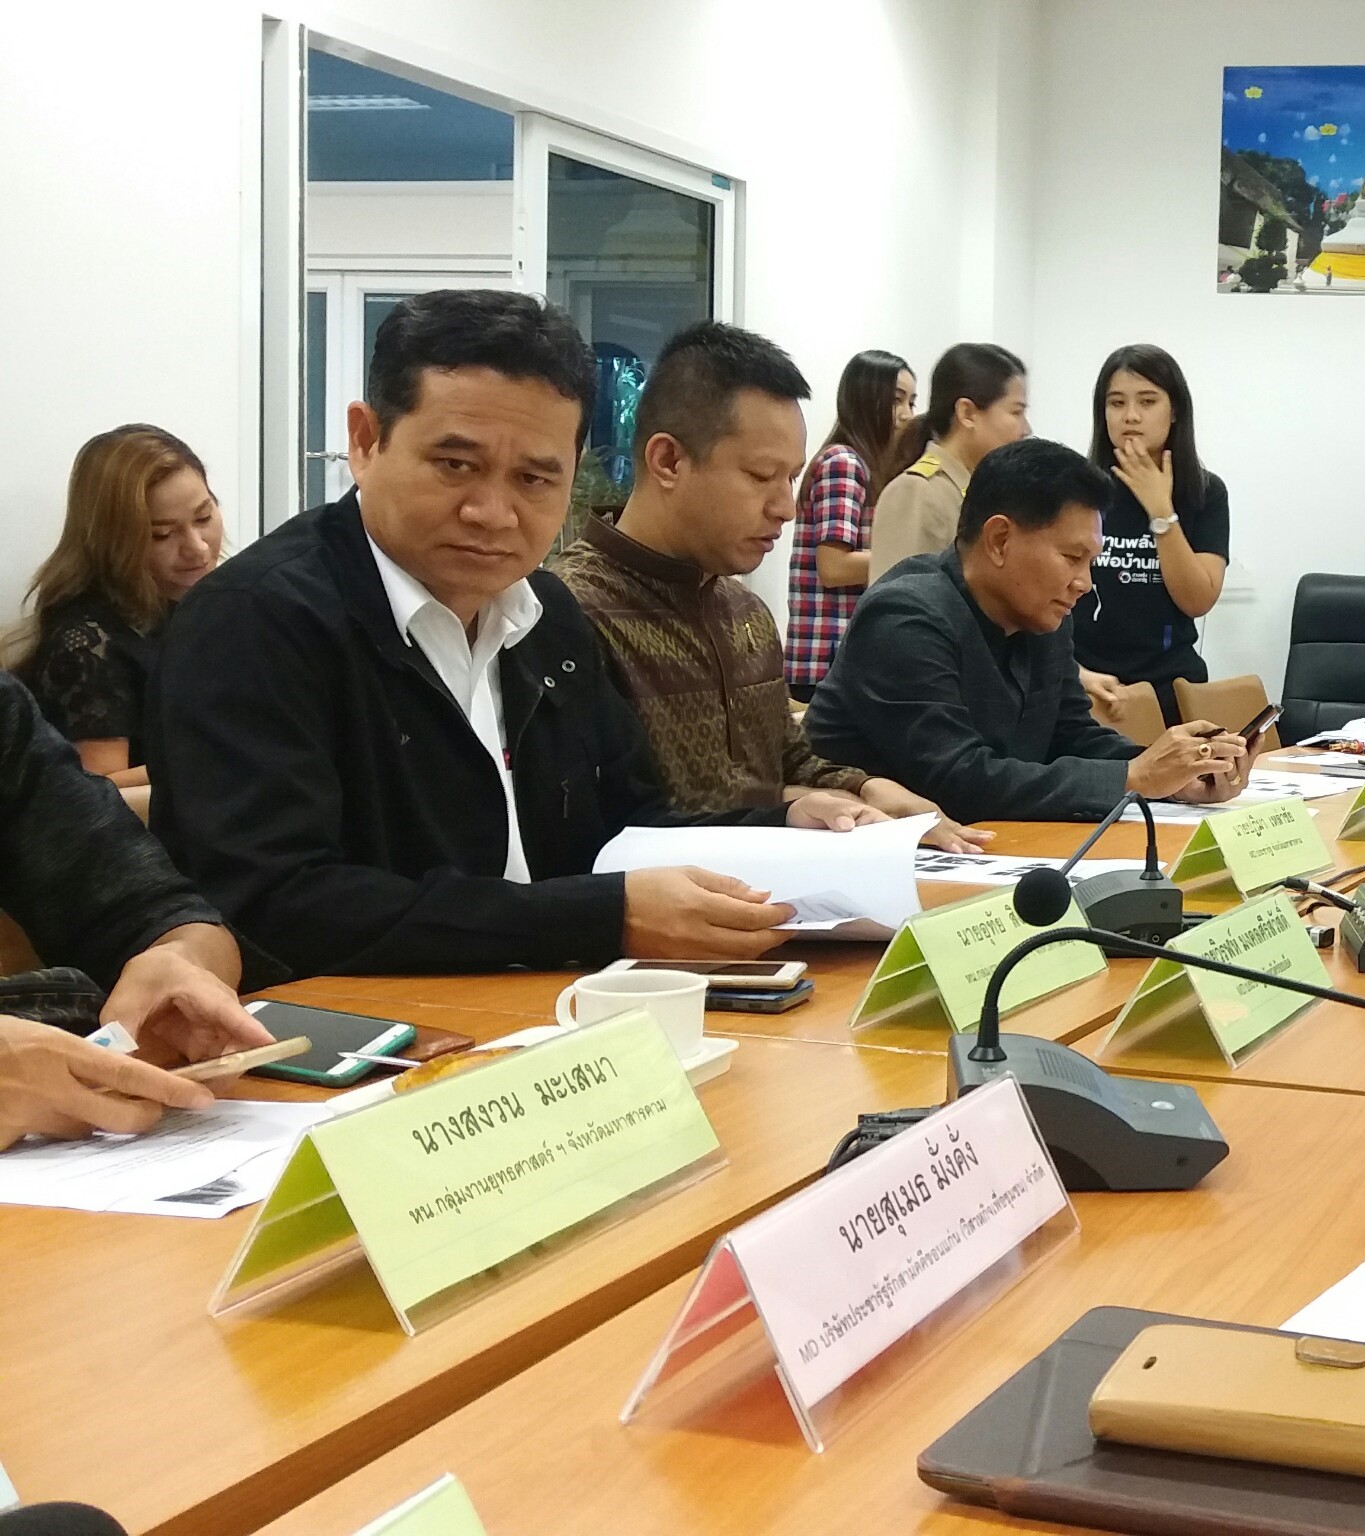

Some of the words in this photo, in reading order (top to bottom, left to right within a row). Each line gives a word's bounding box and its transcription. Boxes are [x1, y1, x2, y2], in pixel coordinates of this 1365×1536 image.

[412, 1091, 526, 1155] นางสงวน
[534, 1056, 619, 1106] มะเสนา
[567, 1098, 668, 1151] จังหวัดมหาสารคาม
[839, 1173, 932, 1253] นายสุเมธ
[924, 1124, 980, 1191] มั่งคั่ง
[798, 1342, 820, 1365] MD
